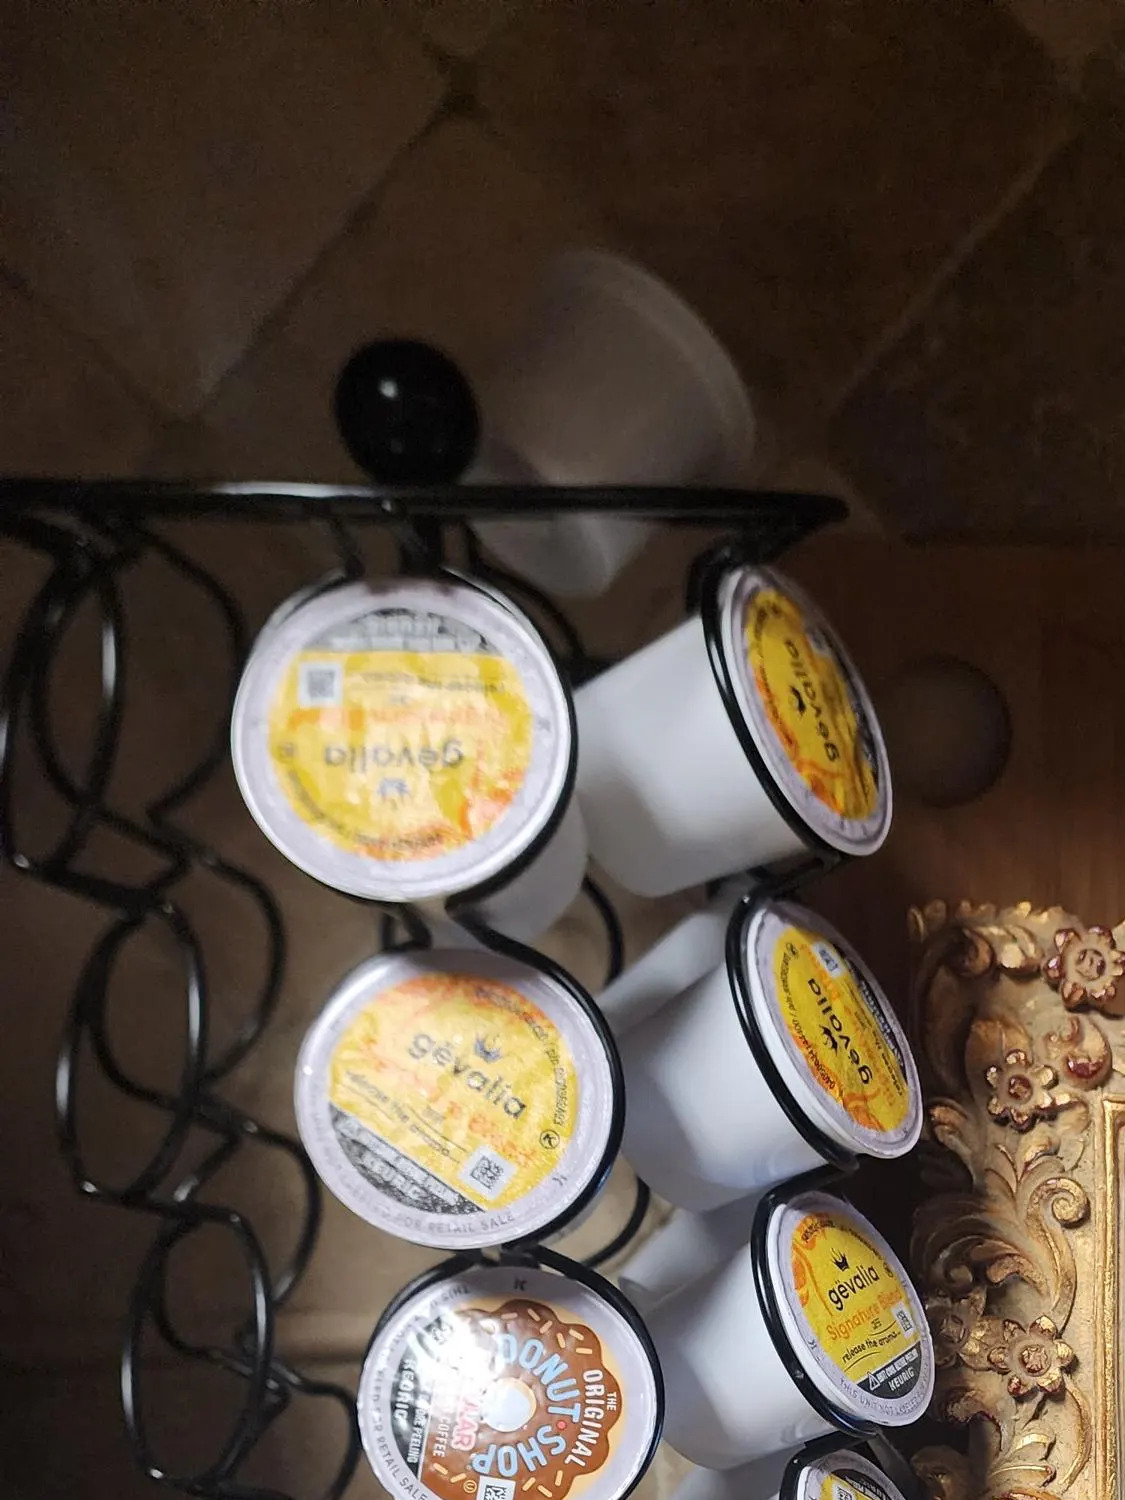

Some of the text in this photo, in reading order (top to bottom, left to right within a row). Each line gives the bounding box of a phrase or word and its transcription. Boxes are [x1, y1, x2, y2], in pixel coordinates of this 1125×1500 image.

[825, 1302, 881, 1342] Signature
[841, 1342, 865, 1364] release
[864, 1334, 879, 1353] the
[887, 1366, 915, 1393] KEURIG
[471, 1332, 582, 1478] DONUT SHOP
[563, 1368, 605, 1468] ORIGINAL
[606, 1391, 618, 1413] THE
[375, 1435, 400, 1479] RETAIL
[406, 1423, 424, 1464] PEELING
[431, 1414, 450, 1459] COFFEE
